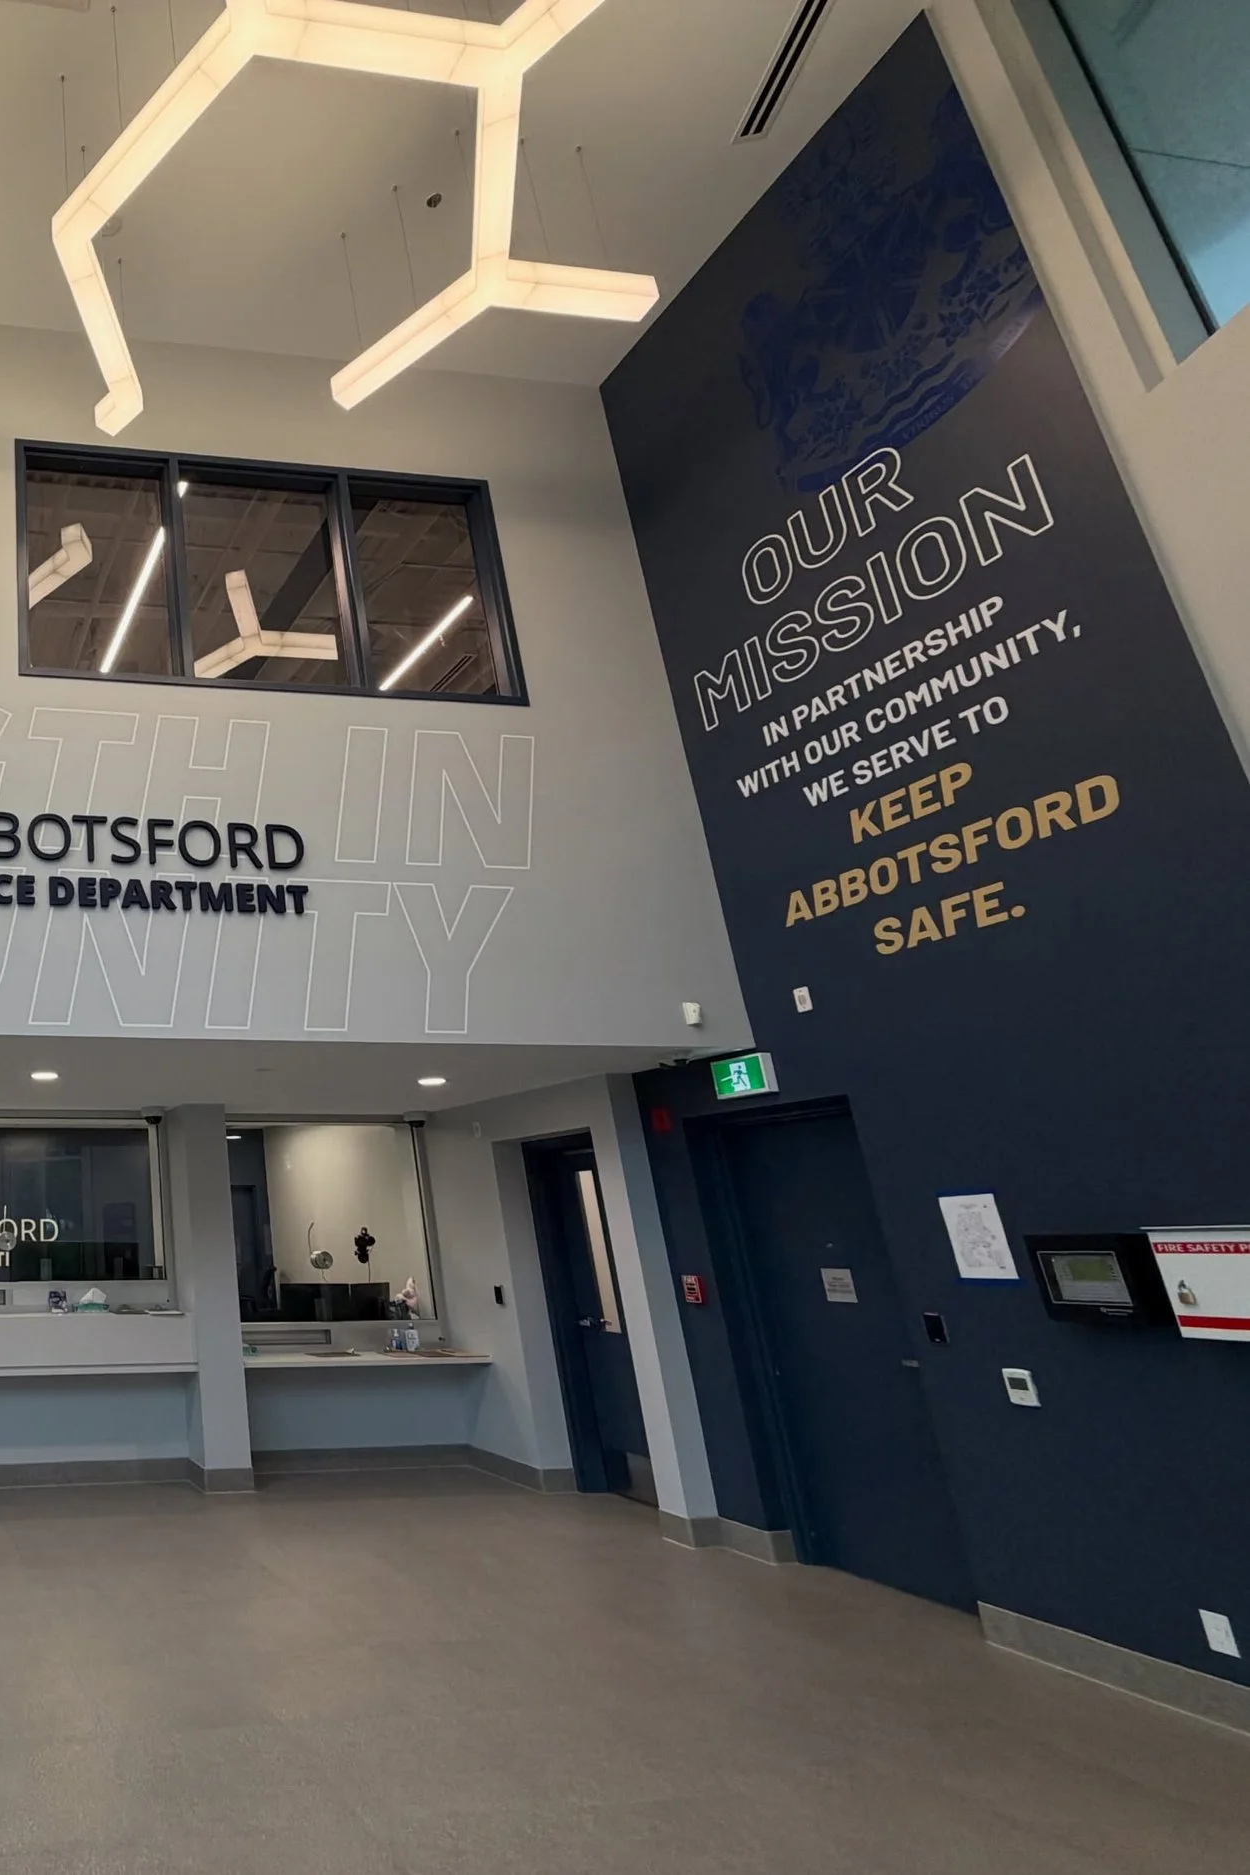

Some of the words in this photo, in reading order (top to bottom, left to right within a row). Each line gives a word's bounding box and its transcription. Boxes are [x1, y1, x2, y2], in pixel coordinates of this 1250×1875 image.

[694, 453, 1055, 731] MISSION
[742, 447, 914, 604] OUR
[736, 751, 801, 798] WITH
[803, 721, 862, 765] OUR
[864, 609, 1082, 734] COMMUNITY,
[762, 716, 789, 747] IN
[792, 595, 1004, 730] PARTNERSHIP
[334, 725, 535, 869] IN
[803, 769, 849, 807] WE
[852, 719, 957, 785] SERVE
[959, 696, 1009, 734] TO
[849, 762, 973, 844] KEEP
[49, 875, 309, 916] DEPARTMENT
[785, 774, 1121, 928] ABBOTSFORD
[873, 881, 1026, 955] SAFE.
[1156, 1243, 1184, 1253] FIRE
[1186, 1243, 1235, 1253] SAFETY
